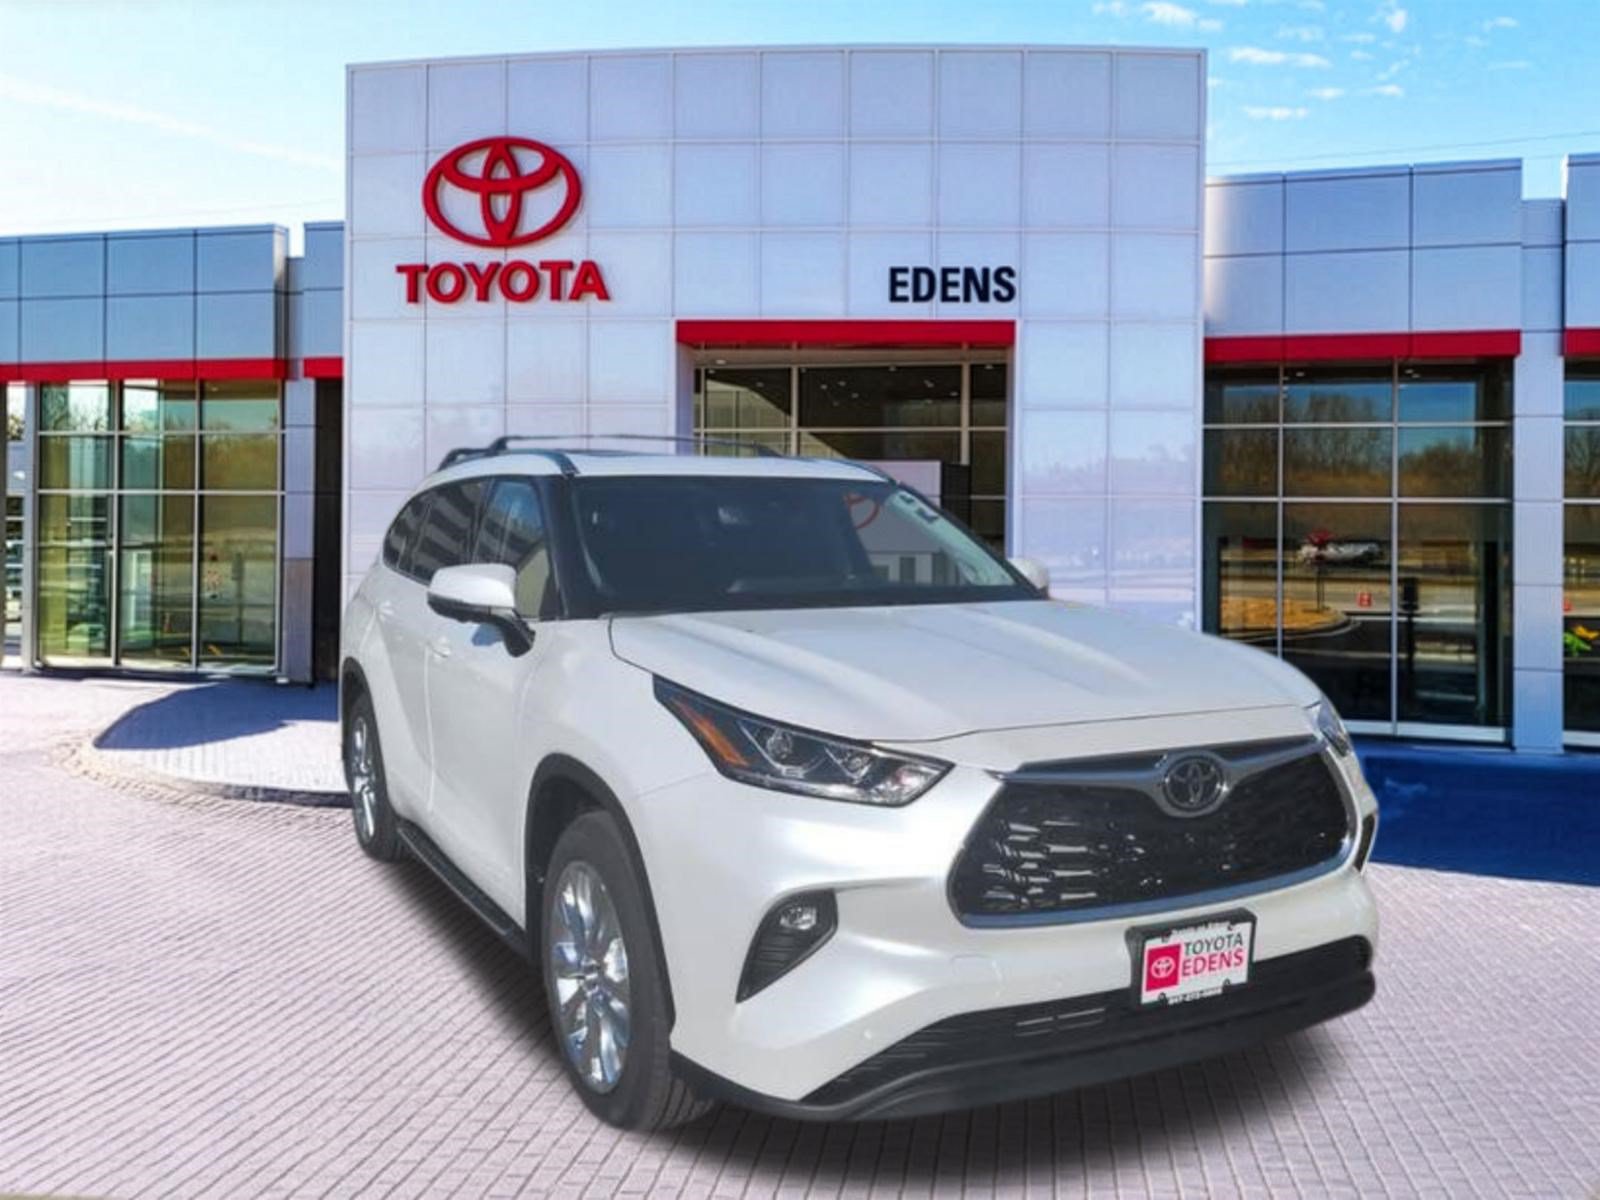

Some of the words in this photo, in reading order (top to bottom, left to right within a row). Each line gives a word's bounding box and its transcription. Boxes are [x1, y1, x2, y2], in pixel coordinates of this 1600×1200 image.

[396, 260, 611, 304] TOYOTA
[889, 266, 1016, 303] EDENS
[1184, 932, 1243, 956] TOYOTA
[1181, 948, 1243, 977] EDENS
